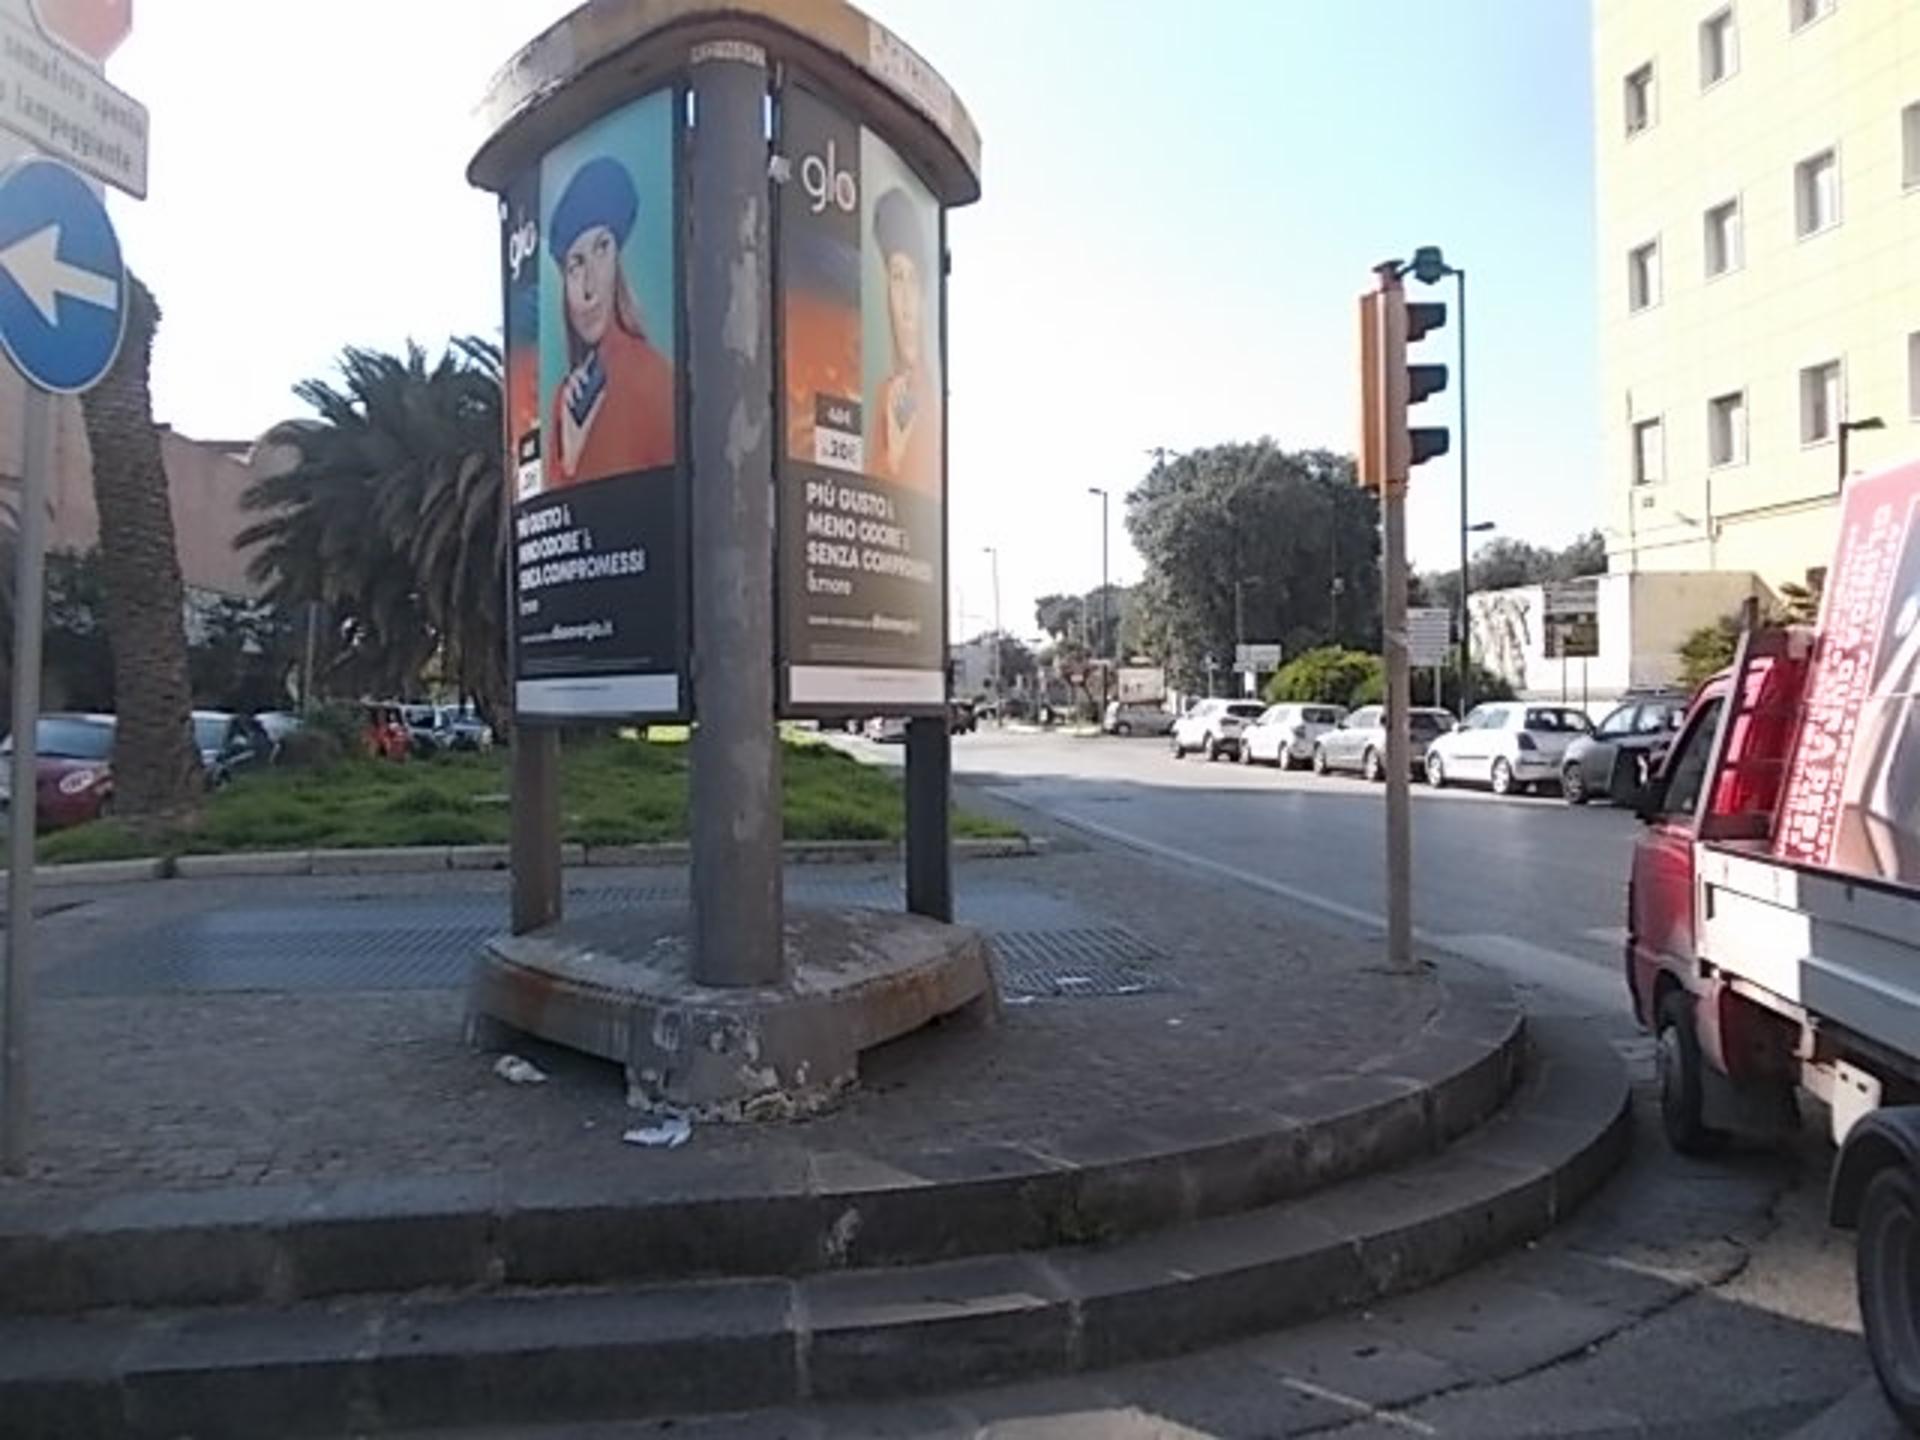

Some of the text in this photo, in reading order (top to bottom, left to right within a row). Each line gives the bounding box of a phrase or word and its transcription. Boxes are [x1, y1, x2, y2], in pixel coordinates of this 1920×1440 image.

[803, 139, 856, 212] glo
[806, 479, 835, 508] PIÙ
[806, 510, 856, 541] MENO
[806, 540, 859, 570] SENZA
